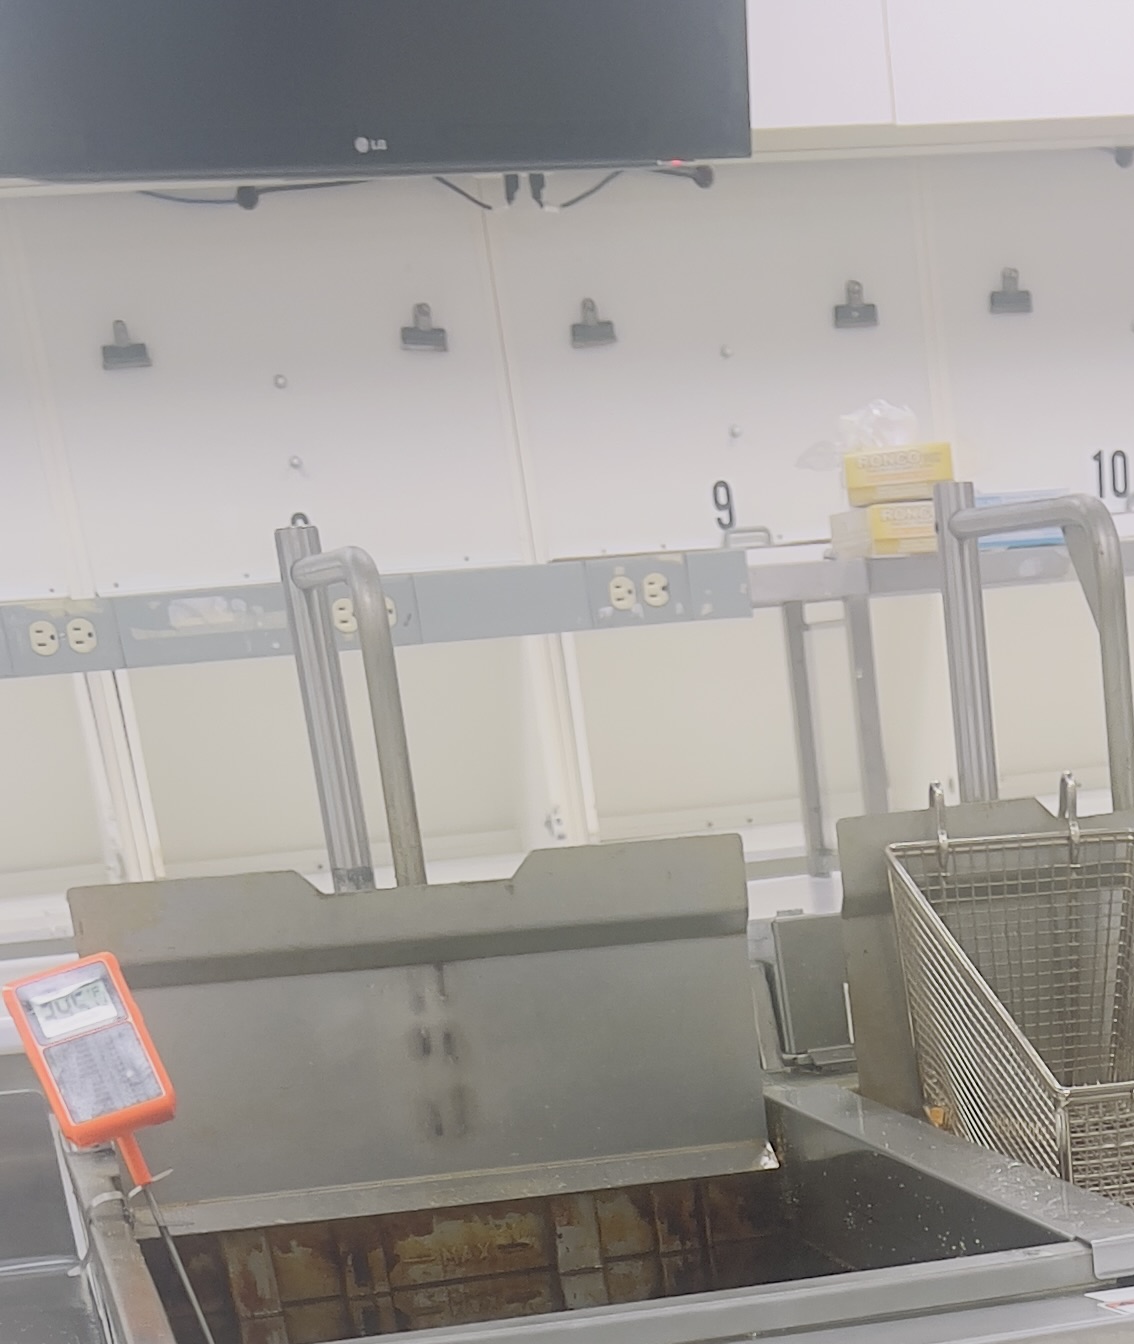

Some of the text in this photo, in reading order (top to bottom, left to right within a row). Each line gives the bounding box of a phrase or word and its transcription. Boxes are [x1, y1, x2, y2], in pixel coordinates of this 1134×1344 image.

[857, 450, 922, 470] RONCO
[1092, 449, 1128, 498] 10
[713, 480, 734, 530] 9
[882, 506, 933, 523] RONC
